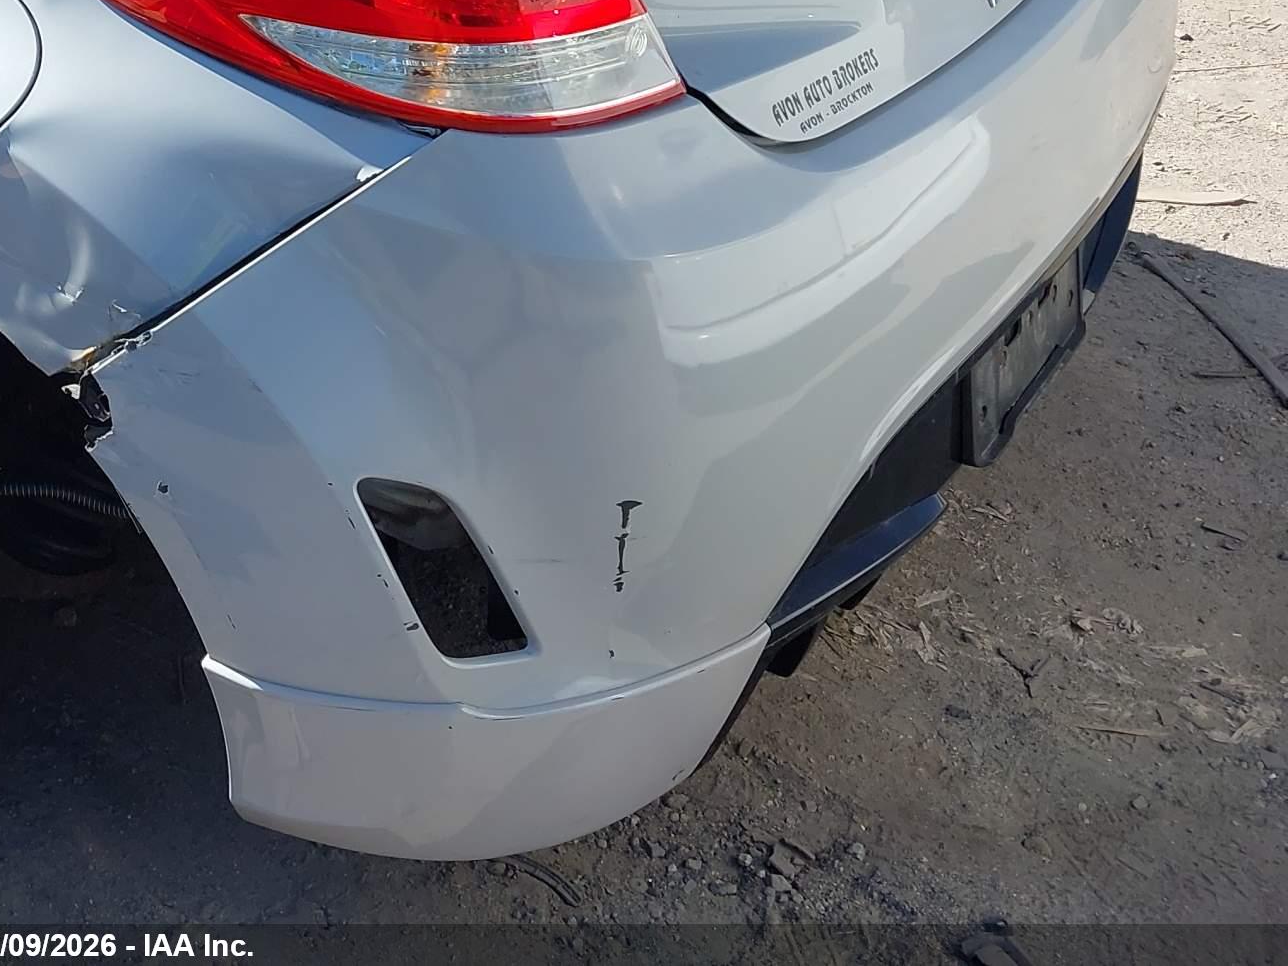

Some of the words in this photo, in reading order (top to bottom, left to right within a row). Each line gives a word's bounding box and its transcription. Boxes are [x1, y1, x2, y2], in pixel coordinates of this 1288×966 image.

[772, 91, 804, 127] AVON
[803, 75, 833, 109] AUTO
[832, 48, 879, 90] BROKERS
[799, 112, 824, 134] AVON
[830, 81, 874, 115] BROCKTON
